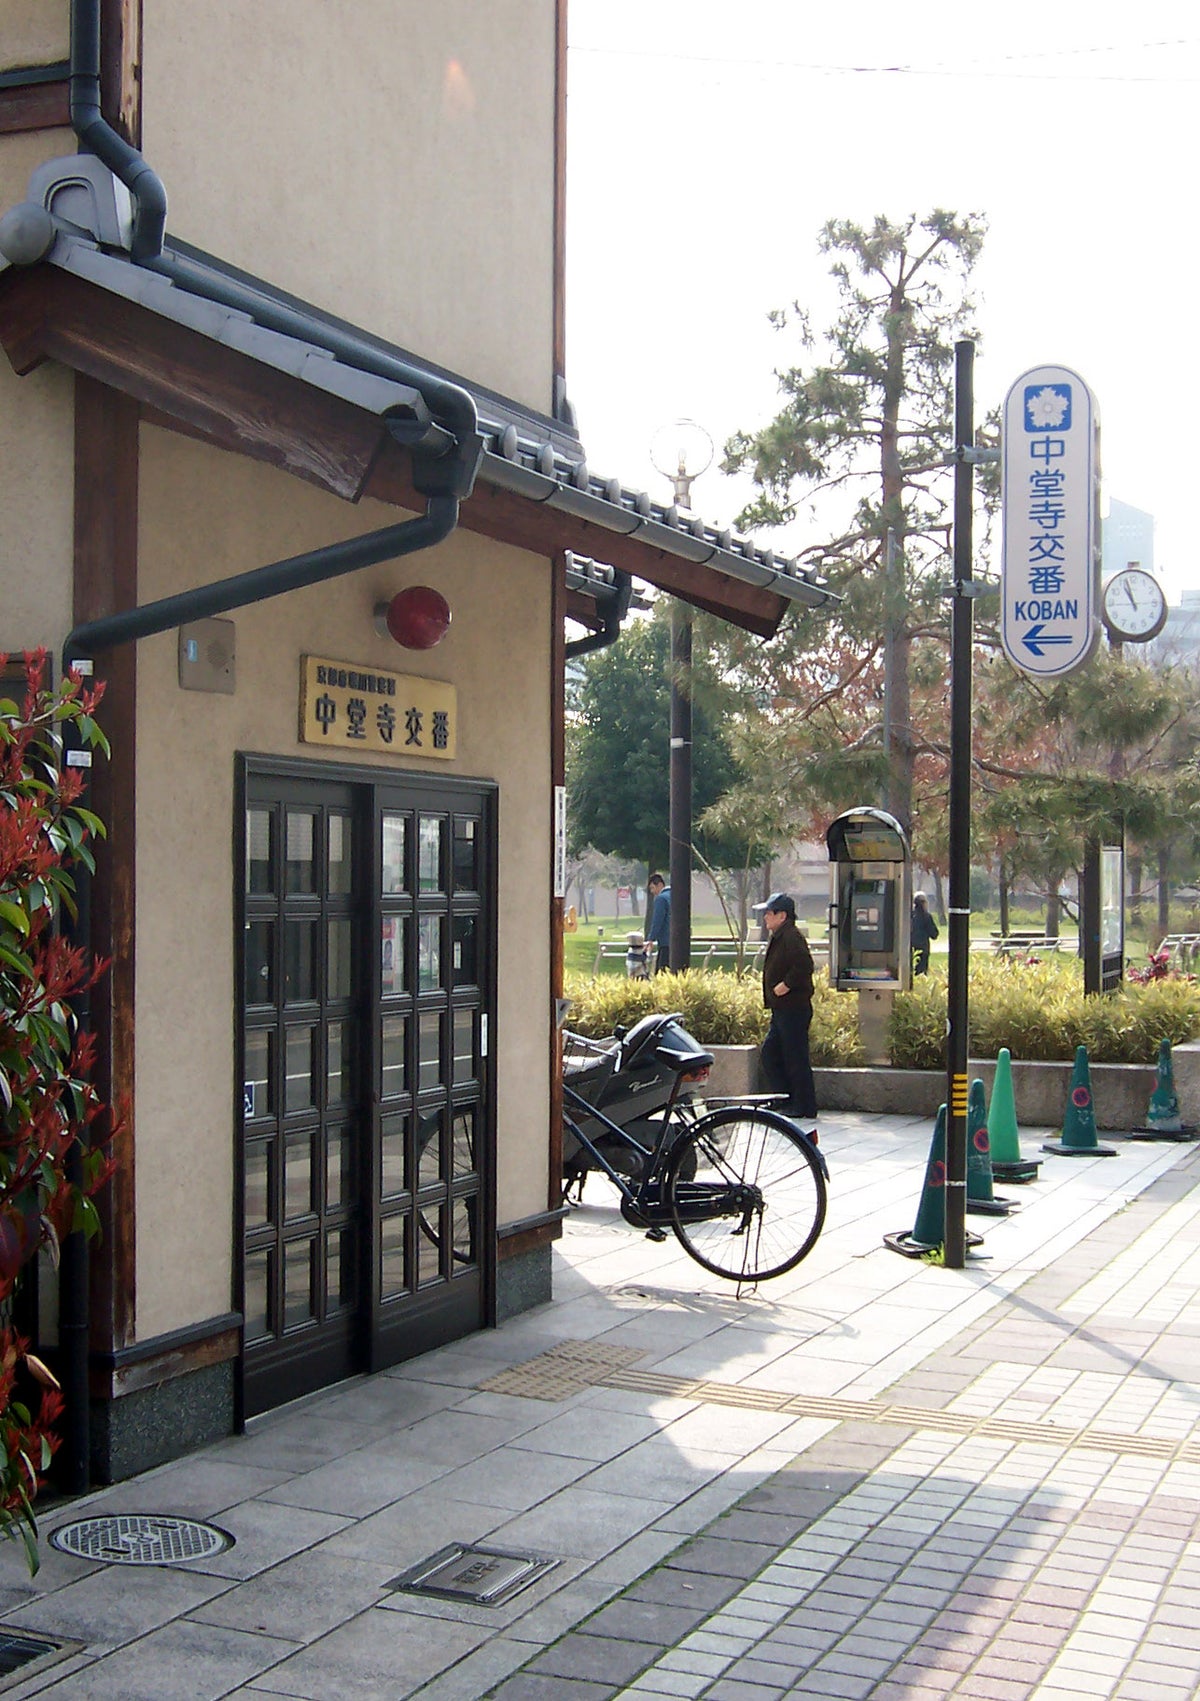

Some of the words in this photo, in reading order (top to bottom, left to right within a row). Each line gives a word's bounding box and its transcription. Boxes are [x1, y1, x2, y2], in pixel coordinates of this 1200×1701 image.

[1028, 435, 1066, 594] 中堂寺交番
[1015, 599, 1078, 622] KOBAN
[315, 692, 449, 749] 中堂寺交番
